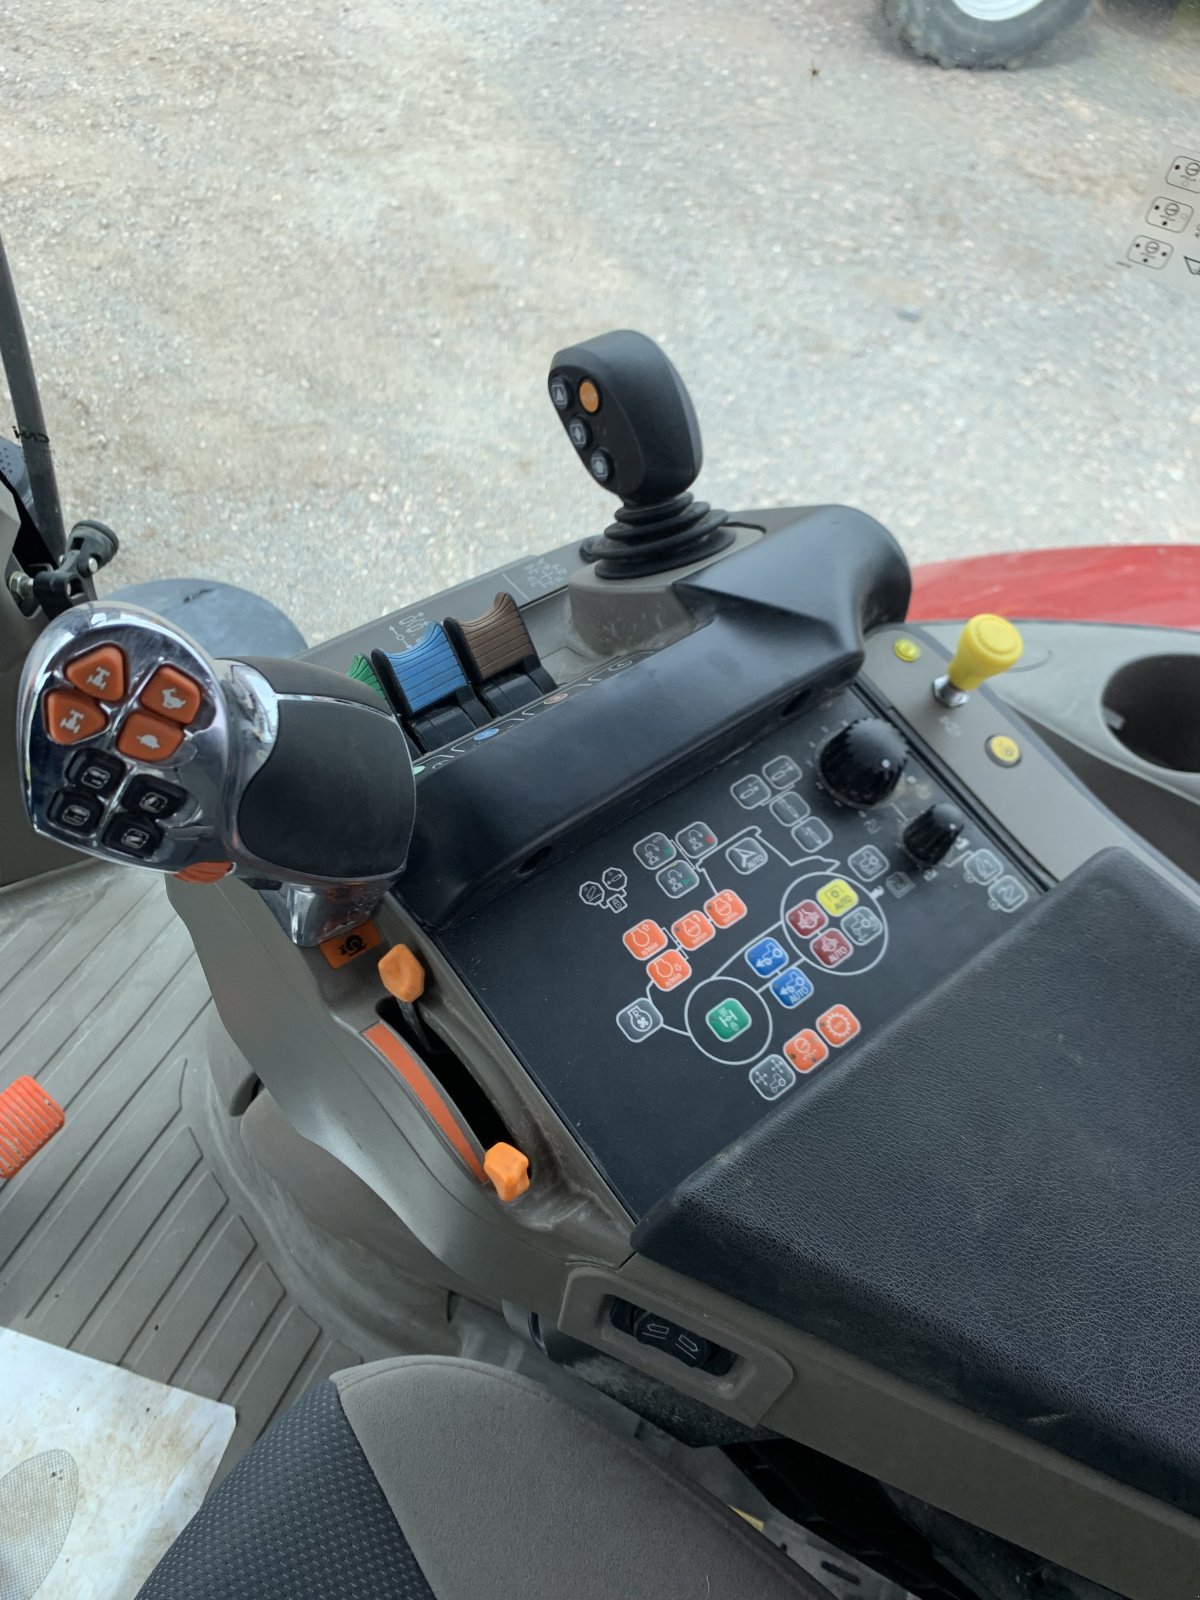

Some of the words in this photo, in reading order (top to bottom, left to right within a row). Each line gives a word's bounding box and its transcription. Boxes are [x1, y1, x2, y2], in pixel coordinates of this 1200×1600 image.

[747, 854, 764, 869] AUTO
[724, 892, 733, 902] 2
[692, 913, 700, 923] 1
[641, 941, 659, 956] n/min
[828, 946, 848, 963] AUTO
[664, 973, 682, 988] n/min
[789, 987, 809, 1004] AUTO
[632, 1009, 641, 1019] R
